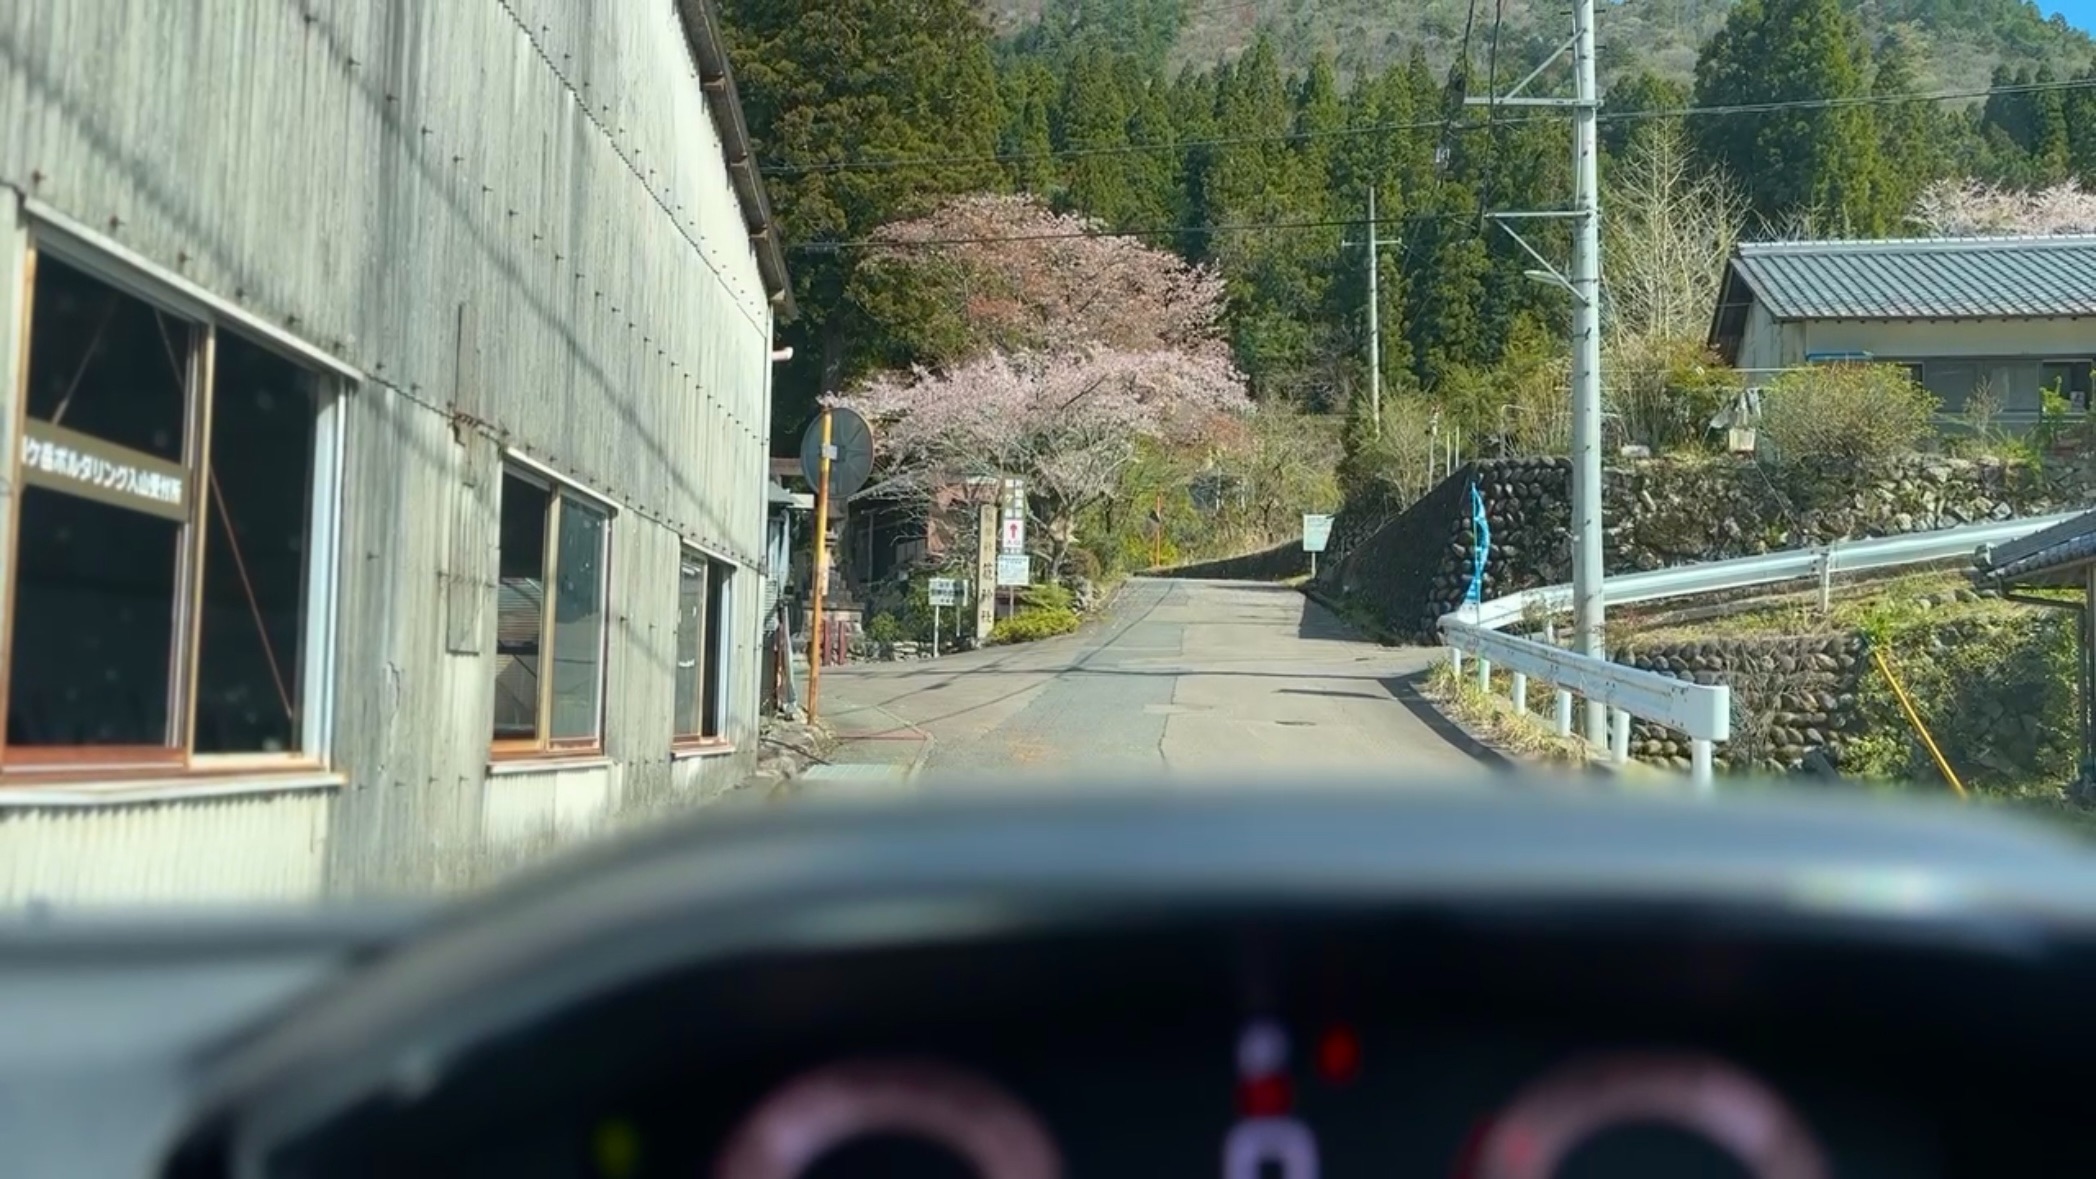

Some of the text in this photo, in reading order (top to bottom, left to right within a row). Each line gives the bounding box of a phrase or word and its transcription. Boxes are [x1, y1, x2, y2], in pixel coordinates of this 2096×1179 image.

[22, 434, 182, 505] ケ岳ボルダリング入山受付所
